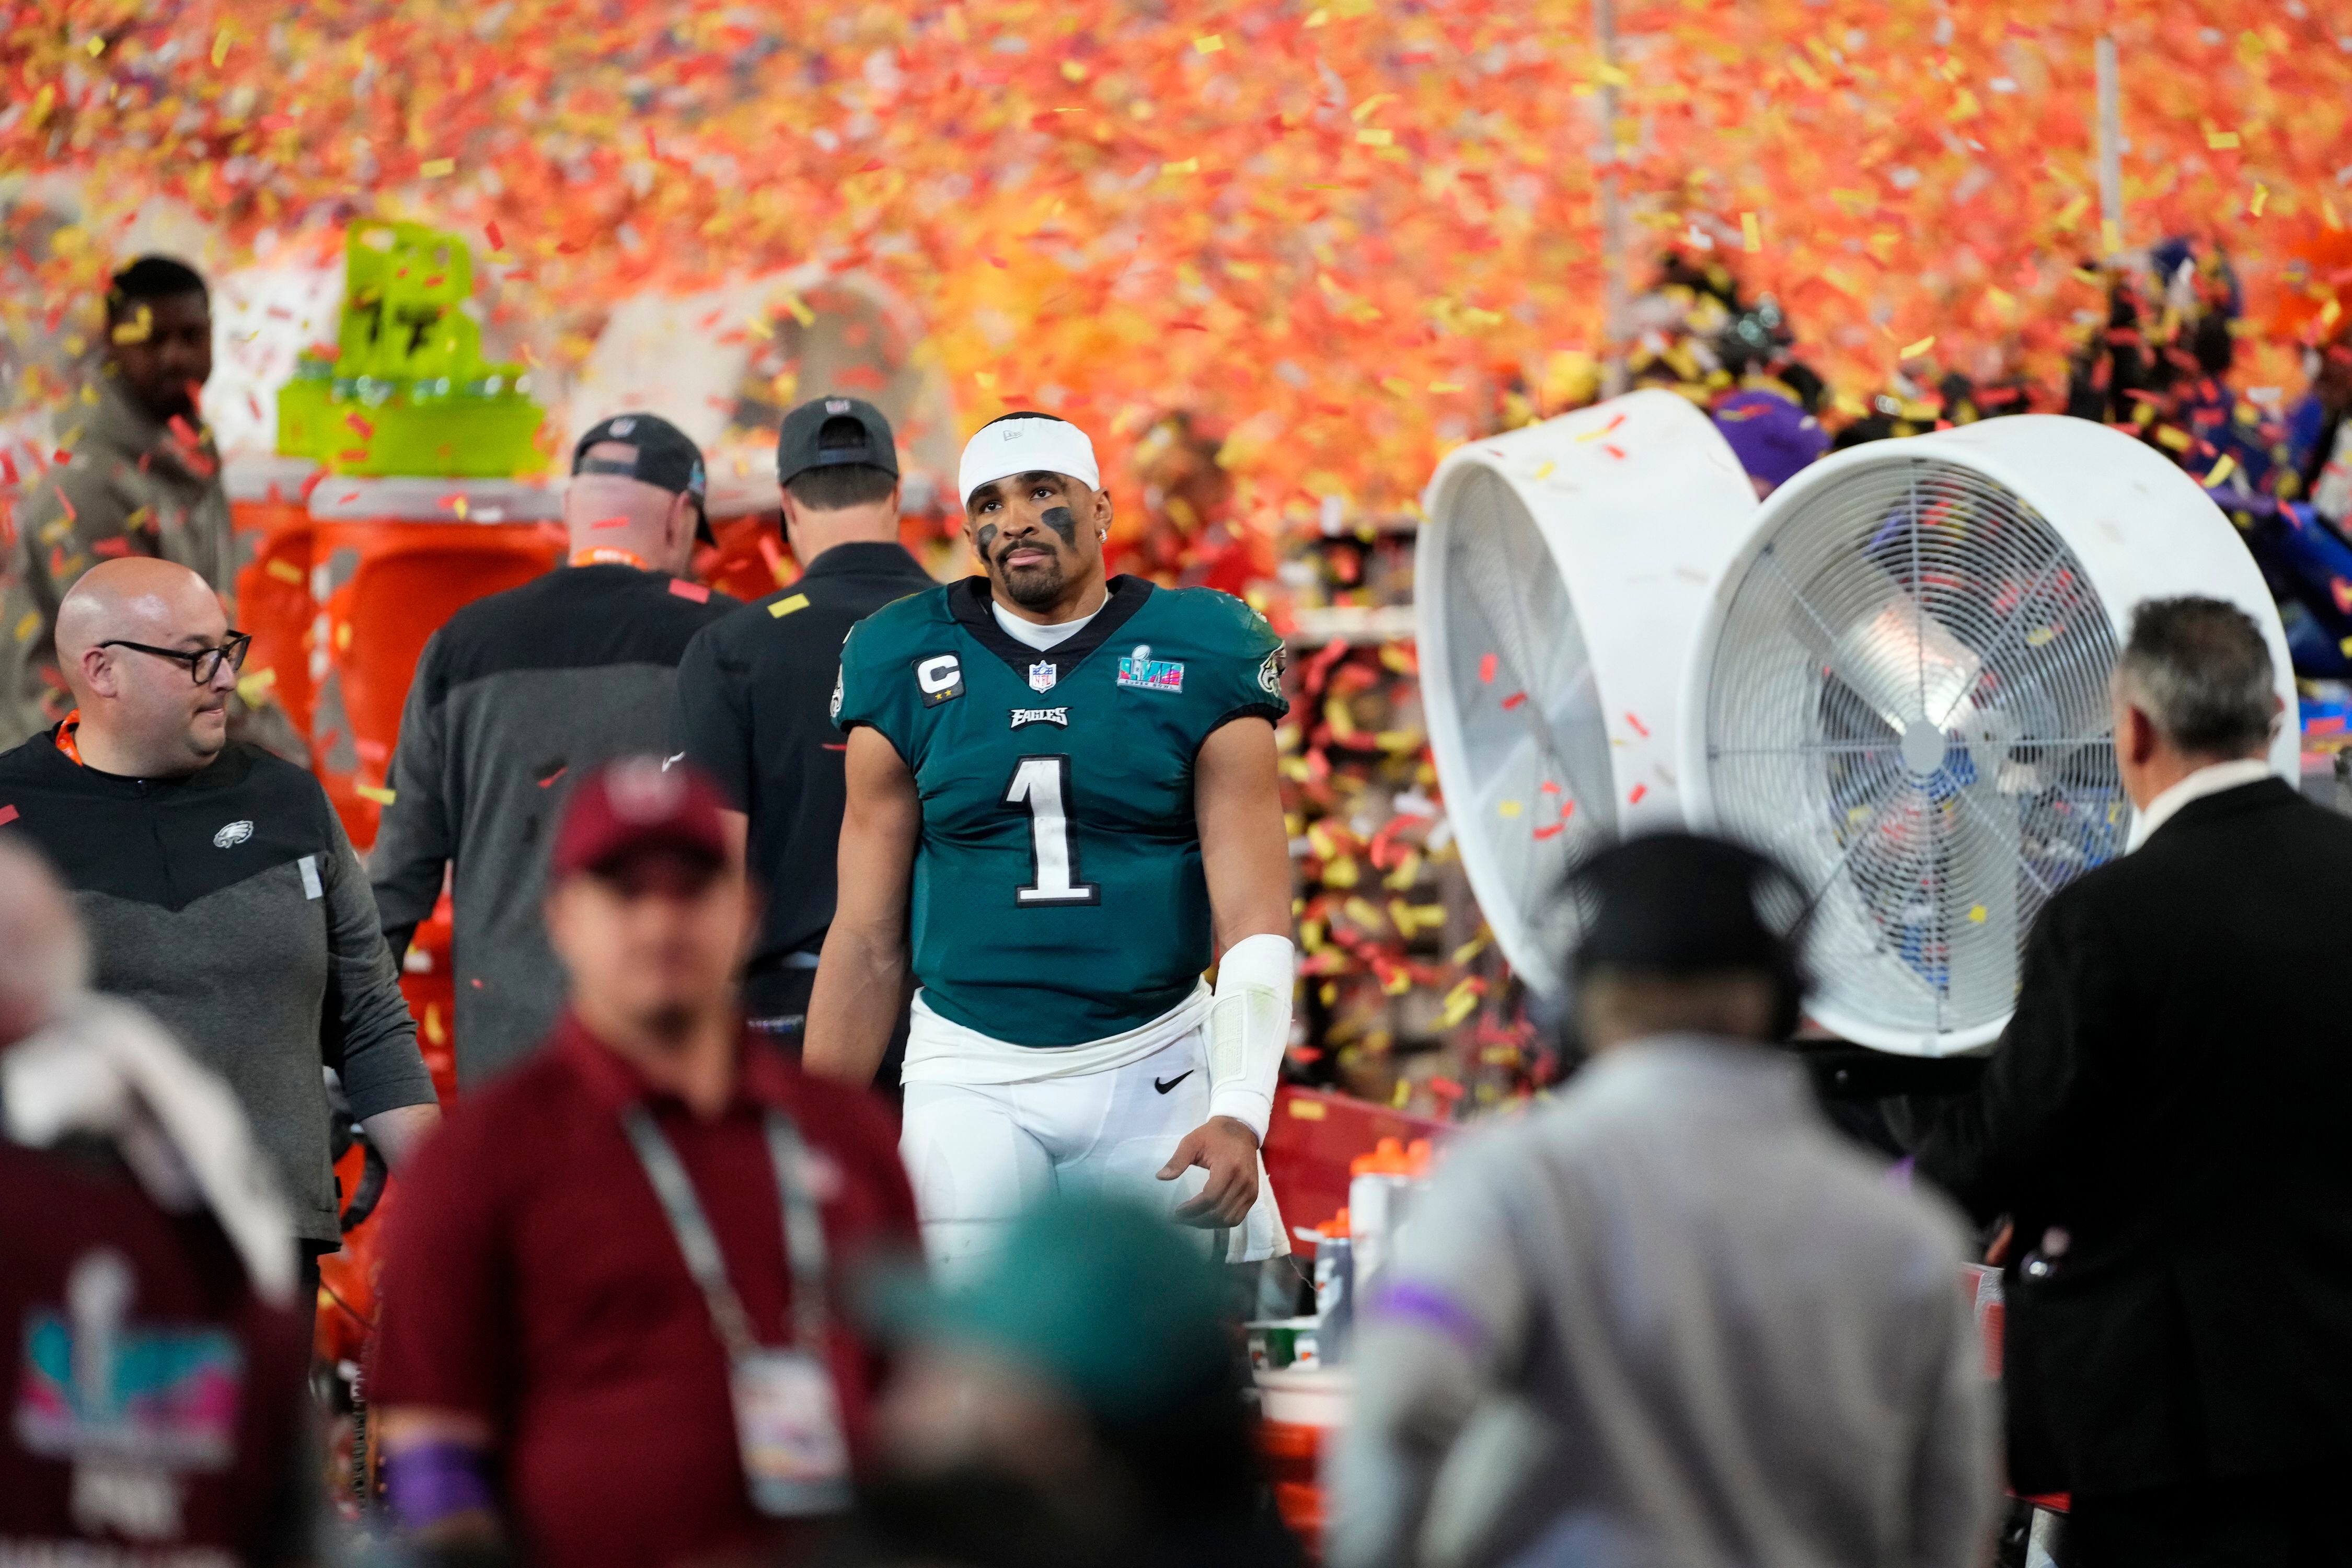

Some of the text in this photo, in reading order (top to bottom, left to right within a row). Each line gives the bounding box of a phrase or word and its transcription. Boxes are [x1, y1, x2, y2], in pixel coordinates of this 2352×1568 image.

[918, 655, 960, 694] C
[1033, 675, 1051, 686] NFL
[1010, 707, 1068, 728] EAGLES
[1001, 757, 1096, 904] 1
